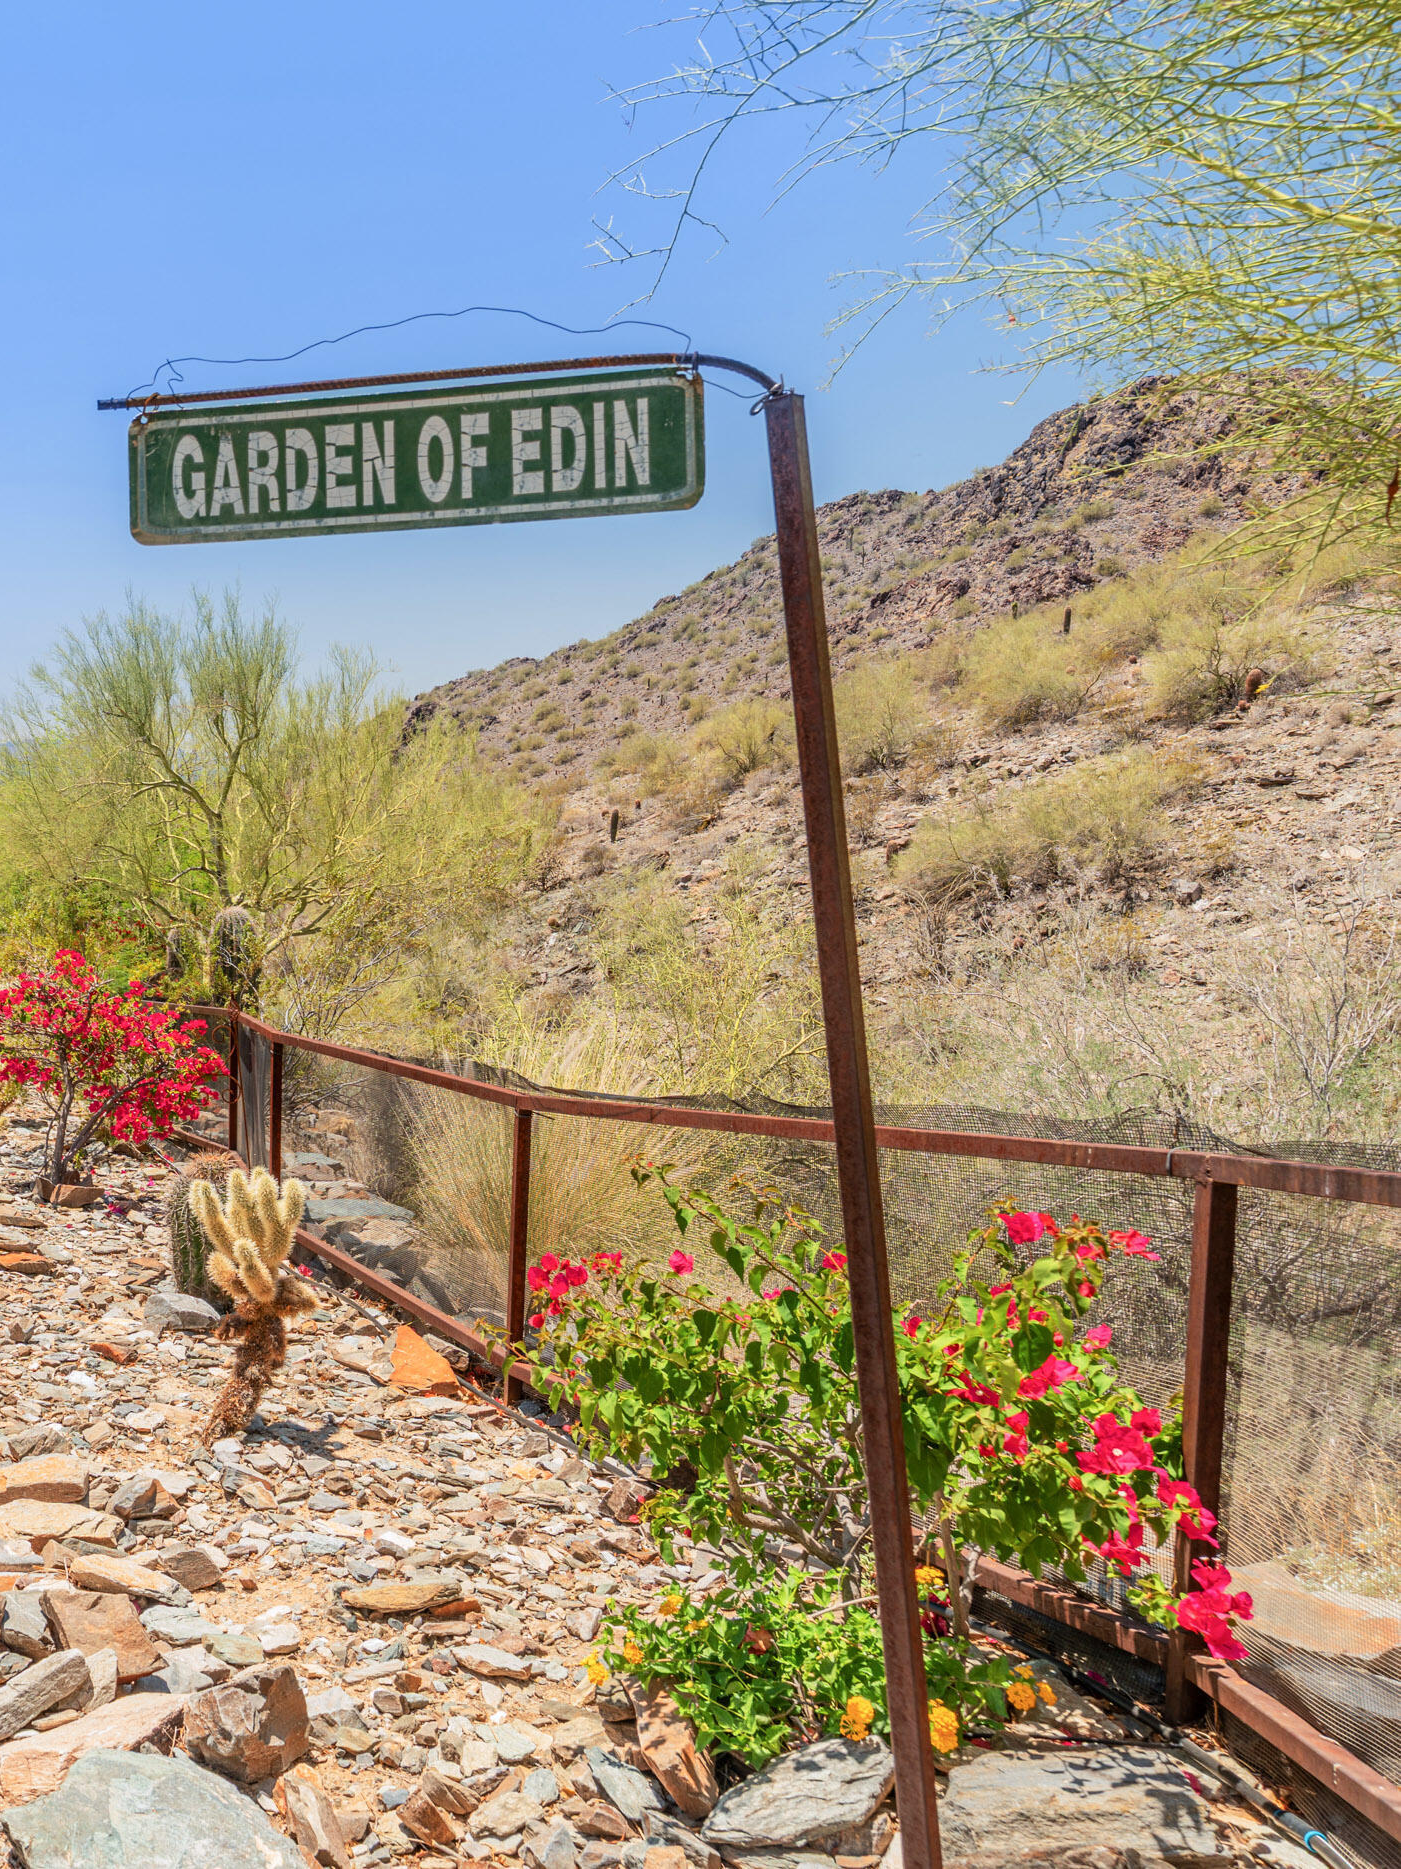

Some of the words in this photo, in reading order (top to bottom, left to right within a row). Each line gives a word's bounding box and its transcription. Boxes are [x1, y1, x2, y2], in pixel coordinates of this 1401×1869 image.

[172, 421, 397, 519] GARDEN
[418, 412, 491, 503] OF
[511, 397, 651, 495] EDIN
